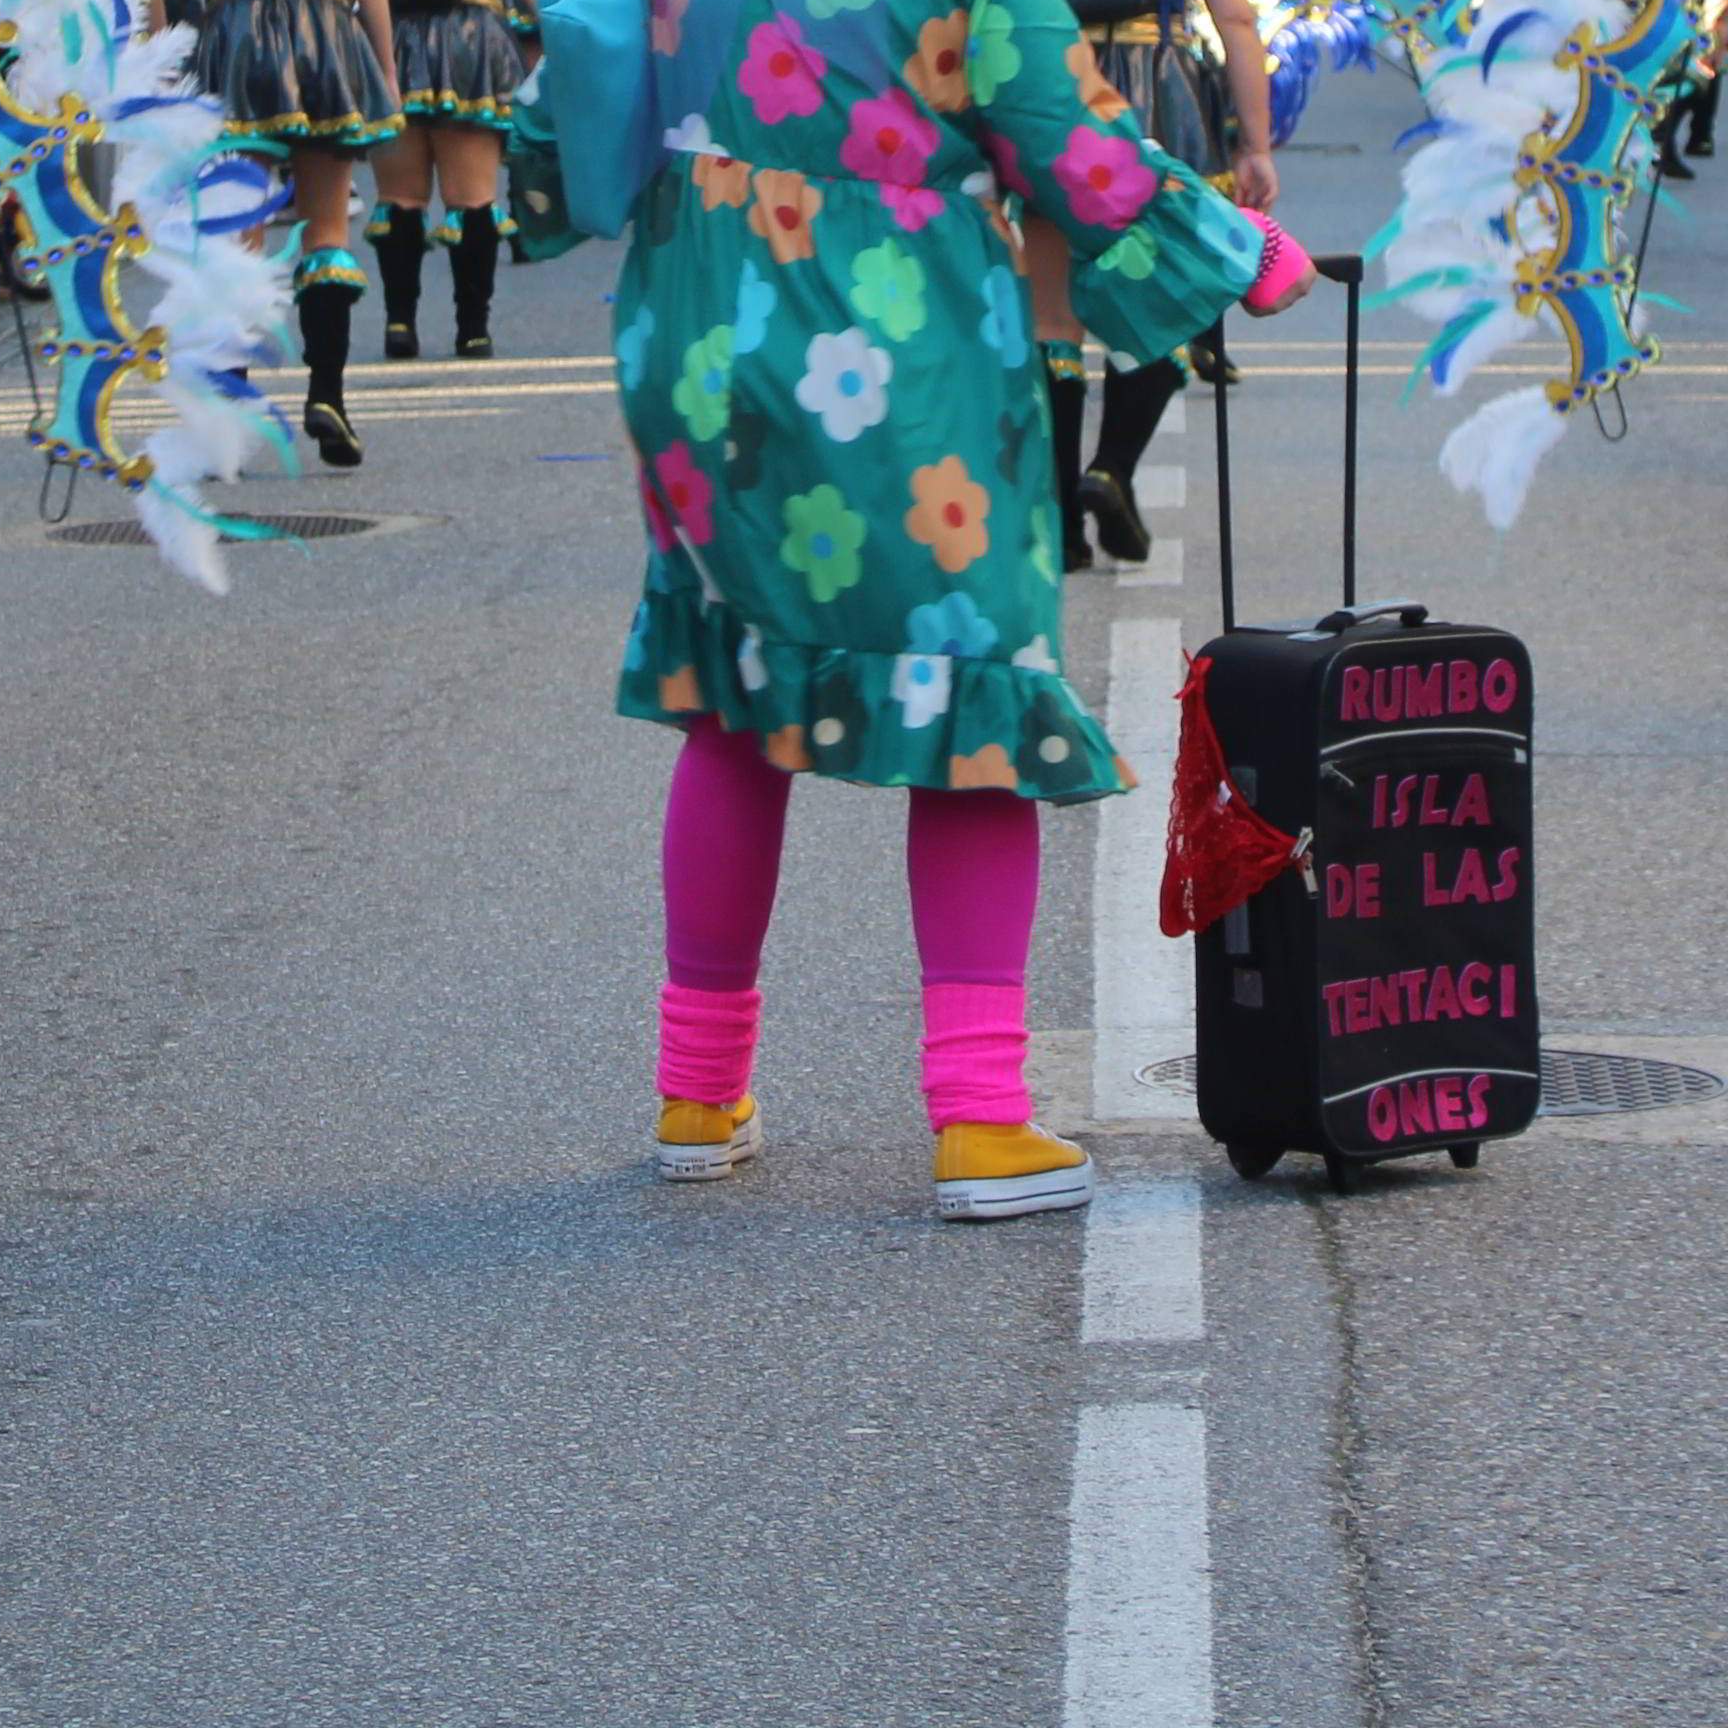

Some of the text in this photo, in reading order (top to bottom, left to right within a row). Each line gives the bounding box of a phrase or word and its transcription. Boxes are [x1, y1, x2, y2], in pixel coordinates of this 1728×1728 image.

[1340, 658, 1518, 723] RUMBO
[1371, 772, 1491, 829] ISLA
[1327, 847, 1520, 919] DE LAS
[1322, 961, 1516, 1037] TENTACI
[1366, 1073, 1491, 1143] ONES
